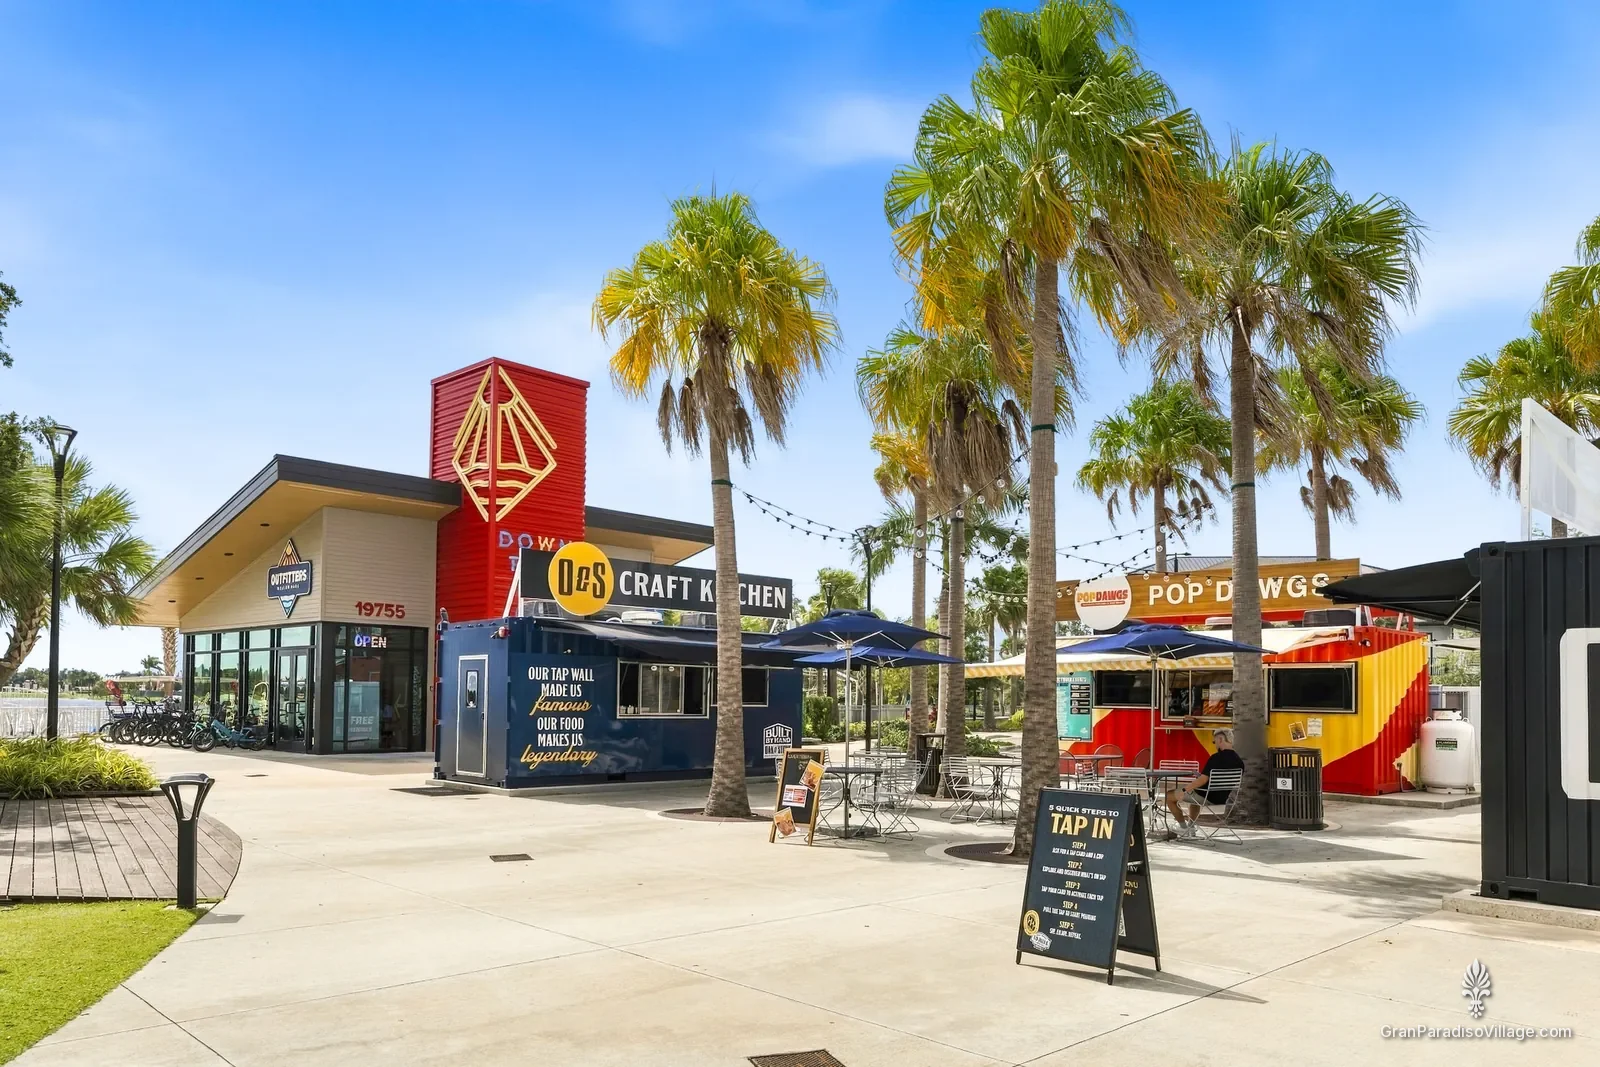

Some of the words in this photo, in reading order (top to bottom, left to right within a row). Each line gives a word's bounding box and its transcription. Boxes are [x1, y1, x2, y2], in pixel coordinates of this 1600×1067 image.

[270, 569, 307, 586] OUTFITTERS
[619, 571, 692, 600] CRAFT
[700, 579, 787, 609] KCHEN
[1077, 590, 1128, 602] POPDAWGS
[1149, 582, 1204, 606] POP
[1216, 573, 1330, 602] DWGS
[355, 601, 406, 619] 19755
[354, 634, 387, 648] OPEN
[528, 666, 549, 680] OUR
[551, 667, 569, 681] TAP
[571, 668, 594, 682] WALL
[541, 683, 568, 697] MADE
[570, 684, 582, 697] US
[529, 694, 592, 716] famous
[351, 716, 374, 725] FREE
[537, 717, 557, 730] OUR
[560, 717, 584, 730] FOOD
[766, 726, 790, 738] BUILT
[538, 733, 569, 747] MAKES
[571, 734, 583, 746] US
[521, 744, 598, 770] legendary
[1081, 808, 1106, 816] STEPS
[1051, 812, 1088, 835] TAP
[1092, 817, 1114, 839] IN
[1065, 880, 1076, 888] STEP
[1062, 900, 1073, 909] STEP
